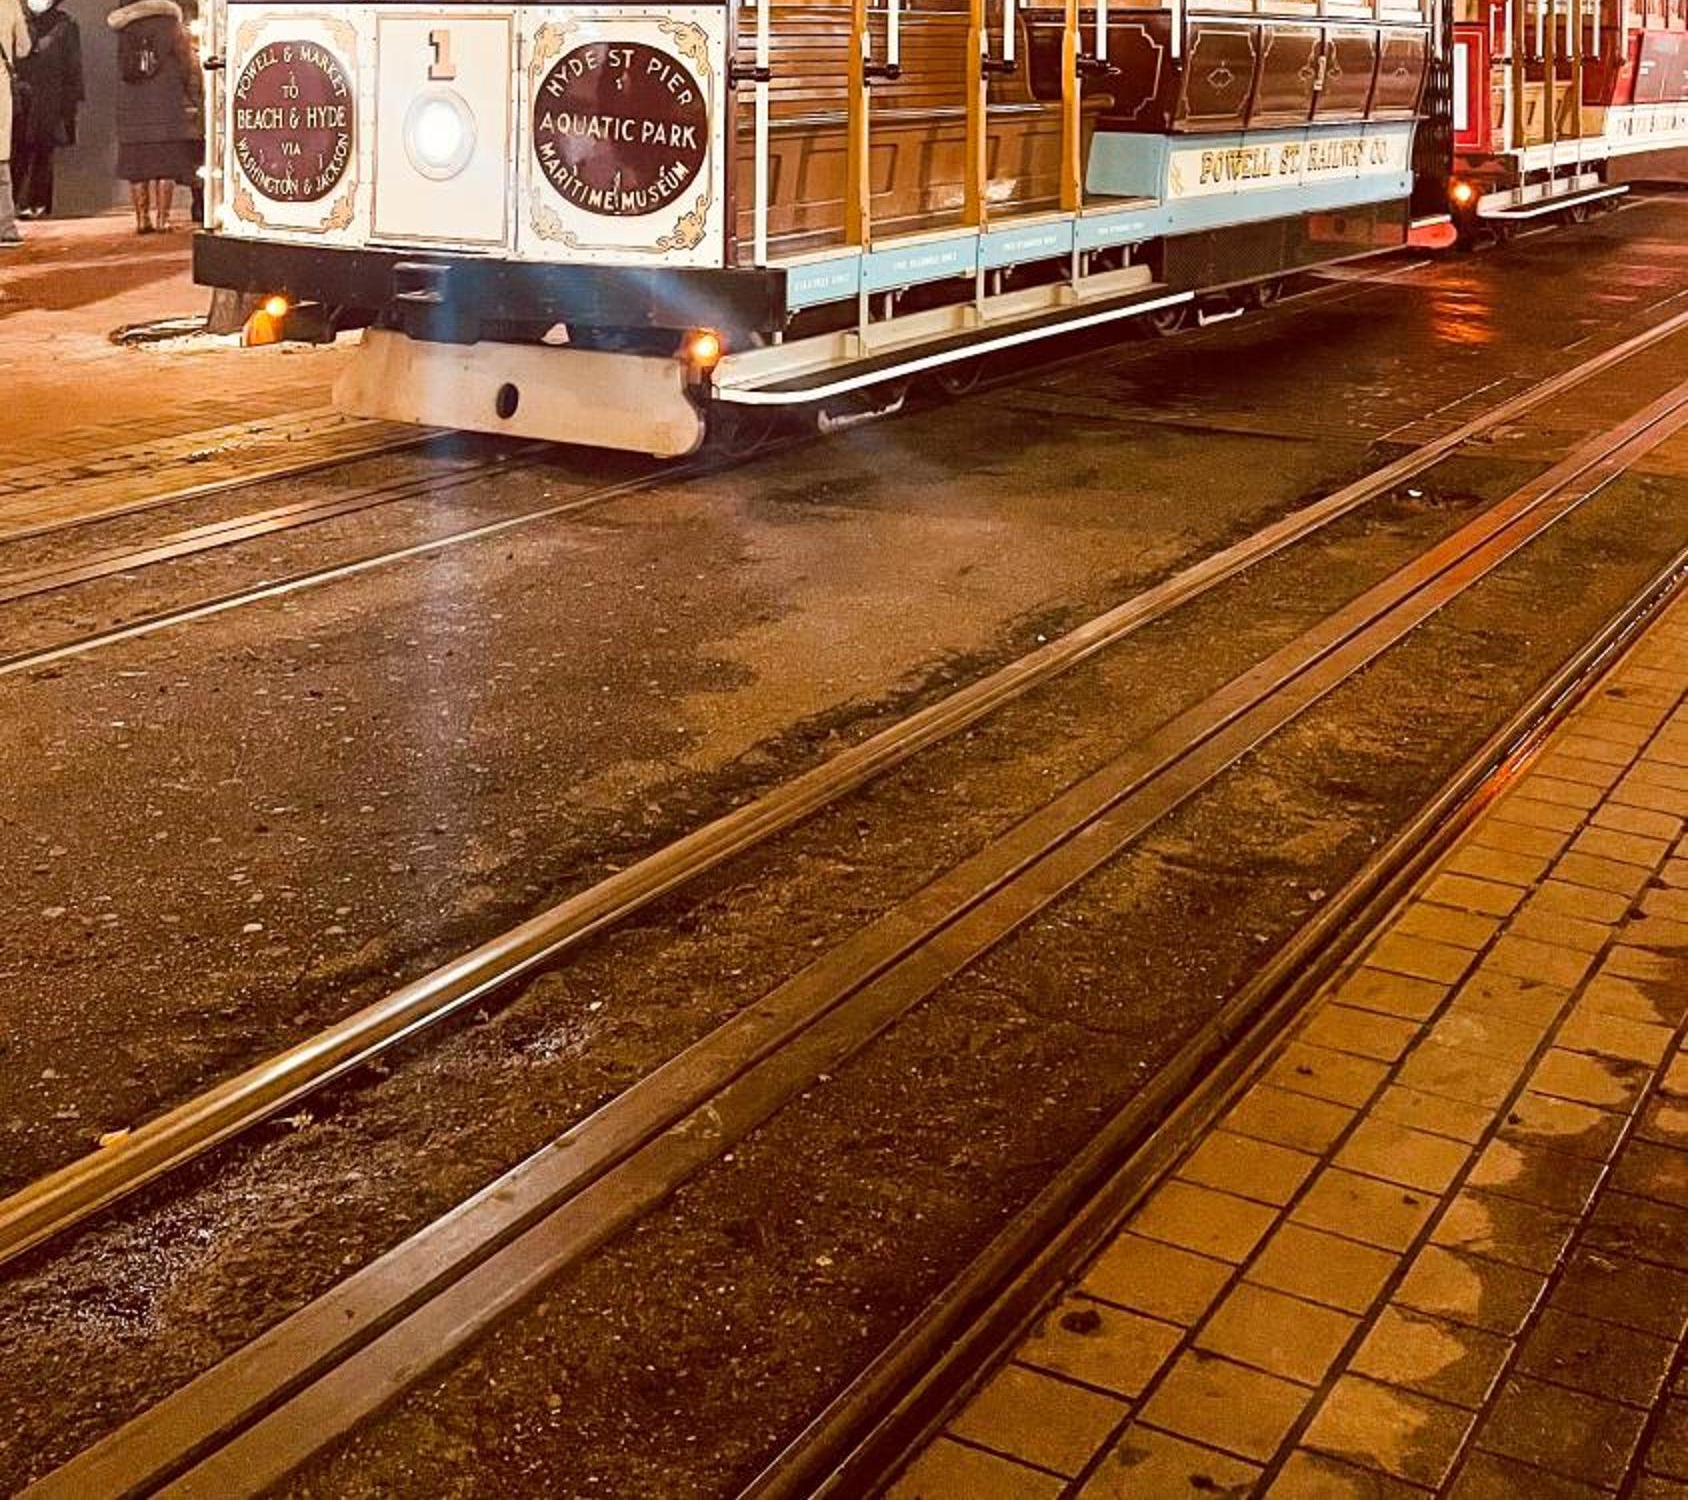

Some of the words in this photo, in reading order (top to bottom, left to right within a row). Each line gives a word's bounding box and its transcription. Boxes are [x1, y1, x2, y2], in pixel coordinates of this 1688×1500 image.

[236, 48, 279, 100] POWELL
[283, 45, 293, 63] &
[299, 46, 347, 98] MARKET
[427, 29, 457, 81] 1
[546, 51, 598, 98] HYDE
[608, 49, 635, 69] ST
[646, 57, 693, 105] PIER
[281, 85, 299, 99] TO
[237, 107, 284, 130] BEACH
[289, 107, 300, 129] &
[306, 105, 347, 129] HYDE
[539, 112, 636, 142] AQUATIC
[641, 120, 698, 150] PARK
[236, 136, 299, 195] WASHINGTON
[303, 179, 312, 195] &
[315, 132, 349, 192] JACKSON
[281, 142, 302, 156] VIA
[1199, 147, 1272, 185] POWELL
[540, 141, 615, 210] MARITIME
[621, 160, 690, 211] MUSEUM
